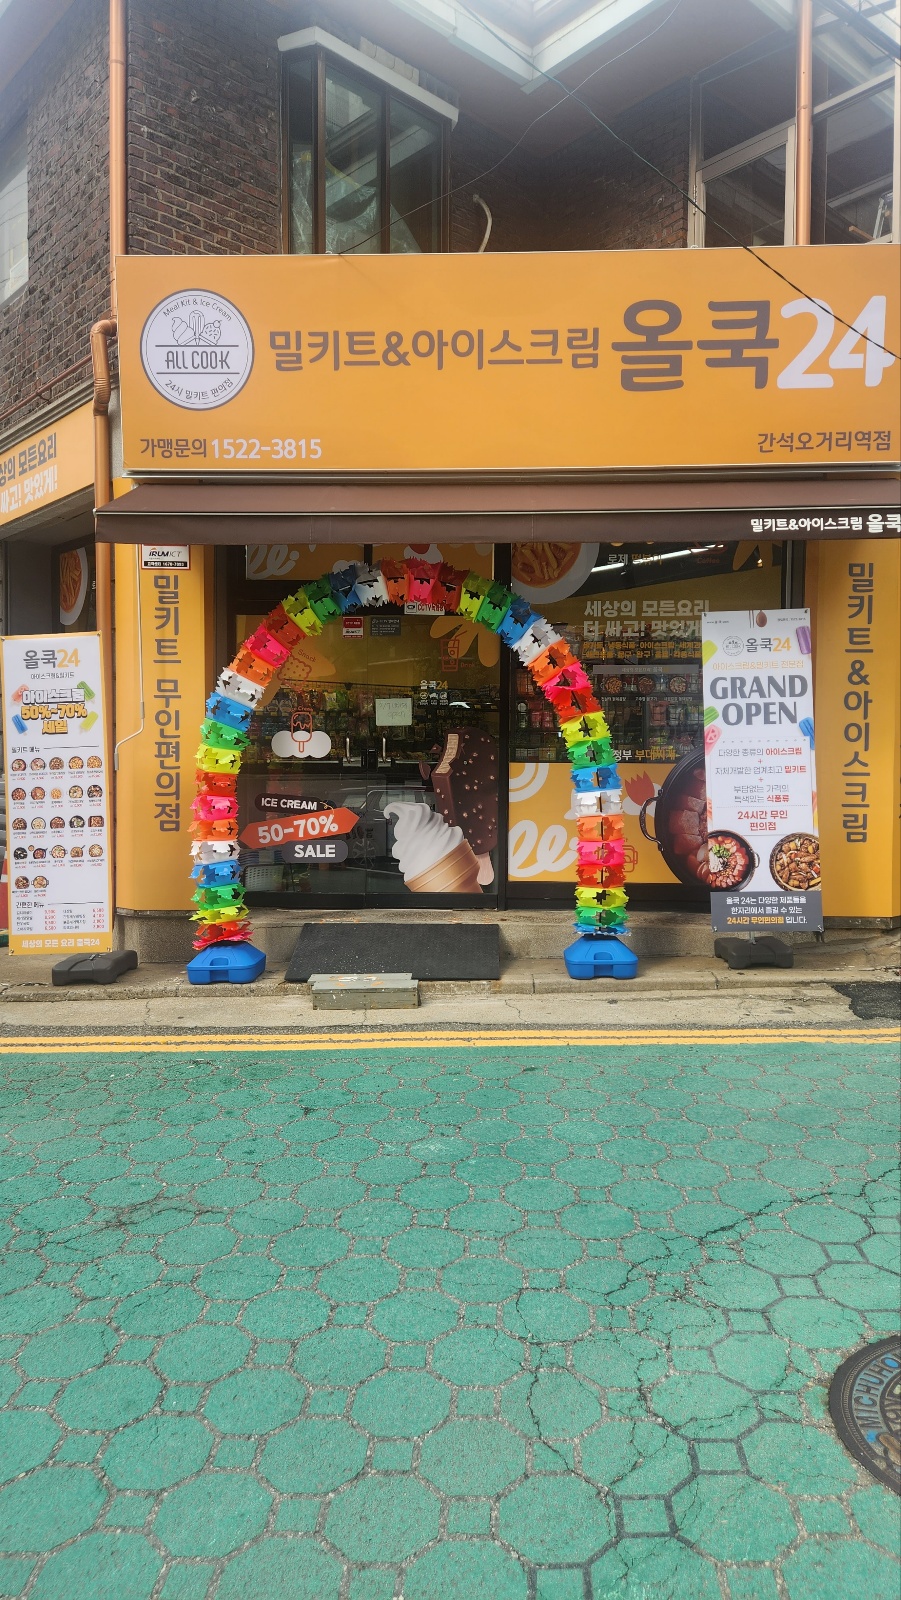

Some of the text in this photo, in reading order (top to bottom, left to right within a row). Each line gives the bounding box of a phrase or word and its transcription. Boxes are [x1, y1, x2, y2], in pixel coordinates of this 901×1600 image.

[162, 302, 180, 317] Meal
[181, 298, 191, 308] Kit
[199, 298, 211, 308] Ice
[211, 302, 233, 322] Cream
[269, 295, 896, 392] 밀키트&아이스크림 올쿡24
[165, 350, 231, 369] ALL COOK
[164, 377, 234, 401] 24시 밀키트 편의점
[140, 438, 323, 459] 가맹문의 1522-3815
[757, 430, 891, 453] 간석오거리역점
[18, 431, 57, 477] 모든요리
[23, 464, 58, 505] 맛있게!
[750, 516, 863, 533] 밀키트&아이스크림
[583, 599, 710, 617] 세상의 모든요리
[153, 574, 182, 664] 밀키트
[583, 620, 600, 641] 더
[604, 620, 645, 637] 싸고!
[745, 636, 792, 653] 올쿡24
[22, 647, 81, 670] 올쿡24
[22, 688, 85, 705] 아이스크림
[709, 674, 809, 700] GRAND
[21, 702, 88, 721] 50%~70%
[841, 562, 875, 843] 밀키트&아이스크림
[721, 701, 798, 726] OPEN
[42, 719, 68, 735] 세일
[153, 678, 182, 833] 무인편의점
[765, 747, 803, 756] 아이스크림
[784, 765, 807, 774] 밀키트
[261, 797, 318, 811] ICE CREAM
[766, 794, 790, 803] 식품류
[737, 810, 788, 820] 24시간 무인
[257, 814, 339, 844] 50-70%
[749, 821, 777, 831] 편의점
[293, 844, 336, 858] SALE
[780, 906, 788, 914] 수
[788, 906, 803, 914] 있는
